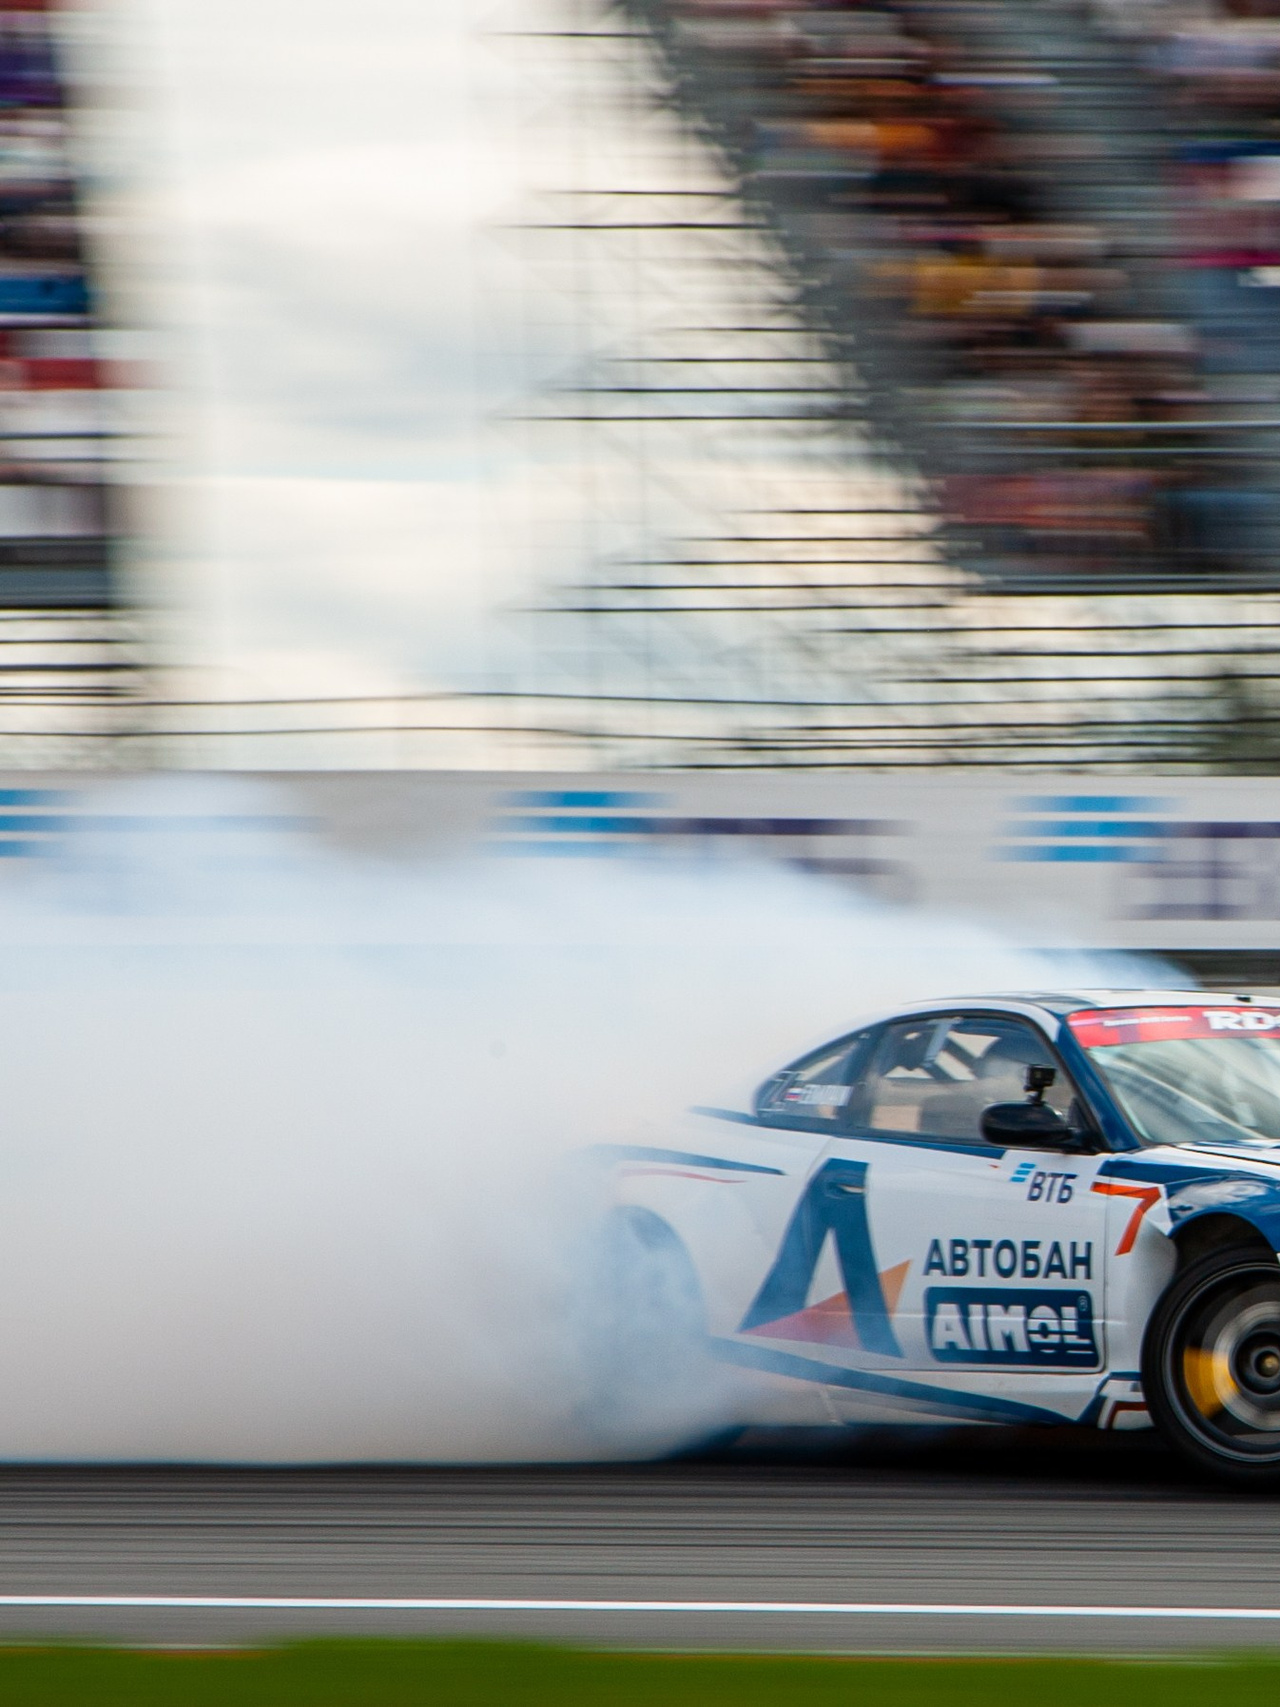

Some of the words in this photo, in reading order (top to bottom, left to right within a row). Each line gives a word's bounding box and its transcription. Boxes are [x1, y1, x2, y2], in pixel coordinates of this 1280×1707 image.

[1027, 1171, 1077, 1204] ВТБ
[923, 1238, 1093, 1280] АВТОБАН
[931, 1303, 1094, 1354] AIMOL
